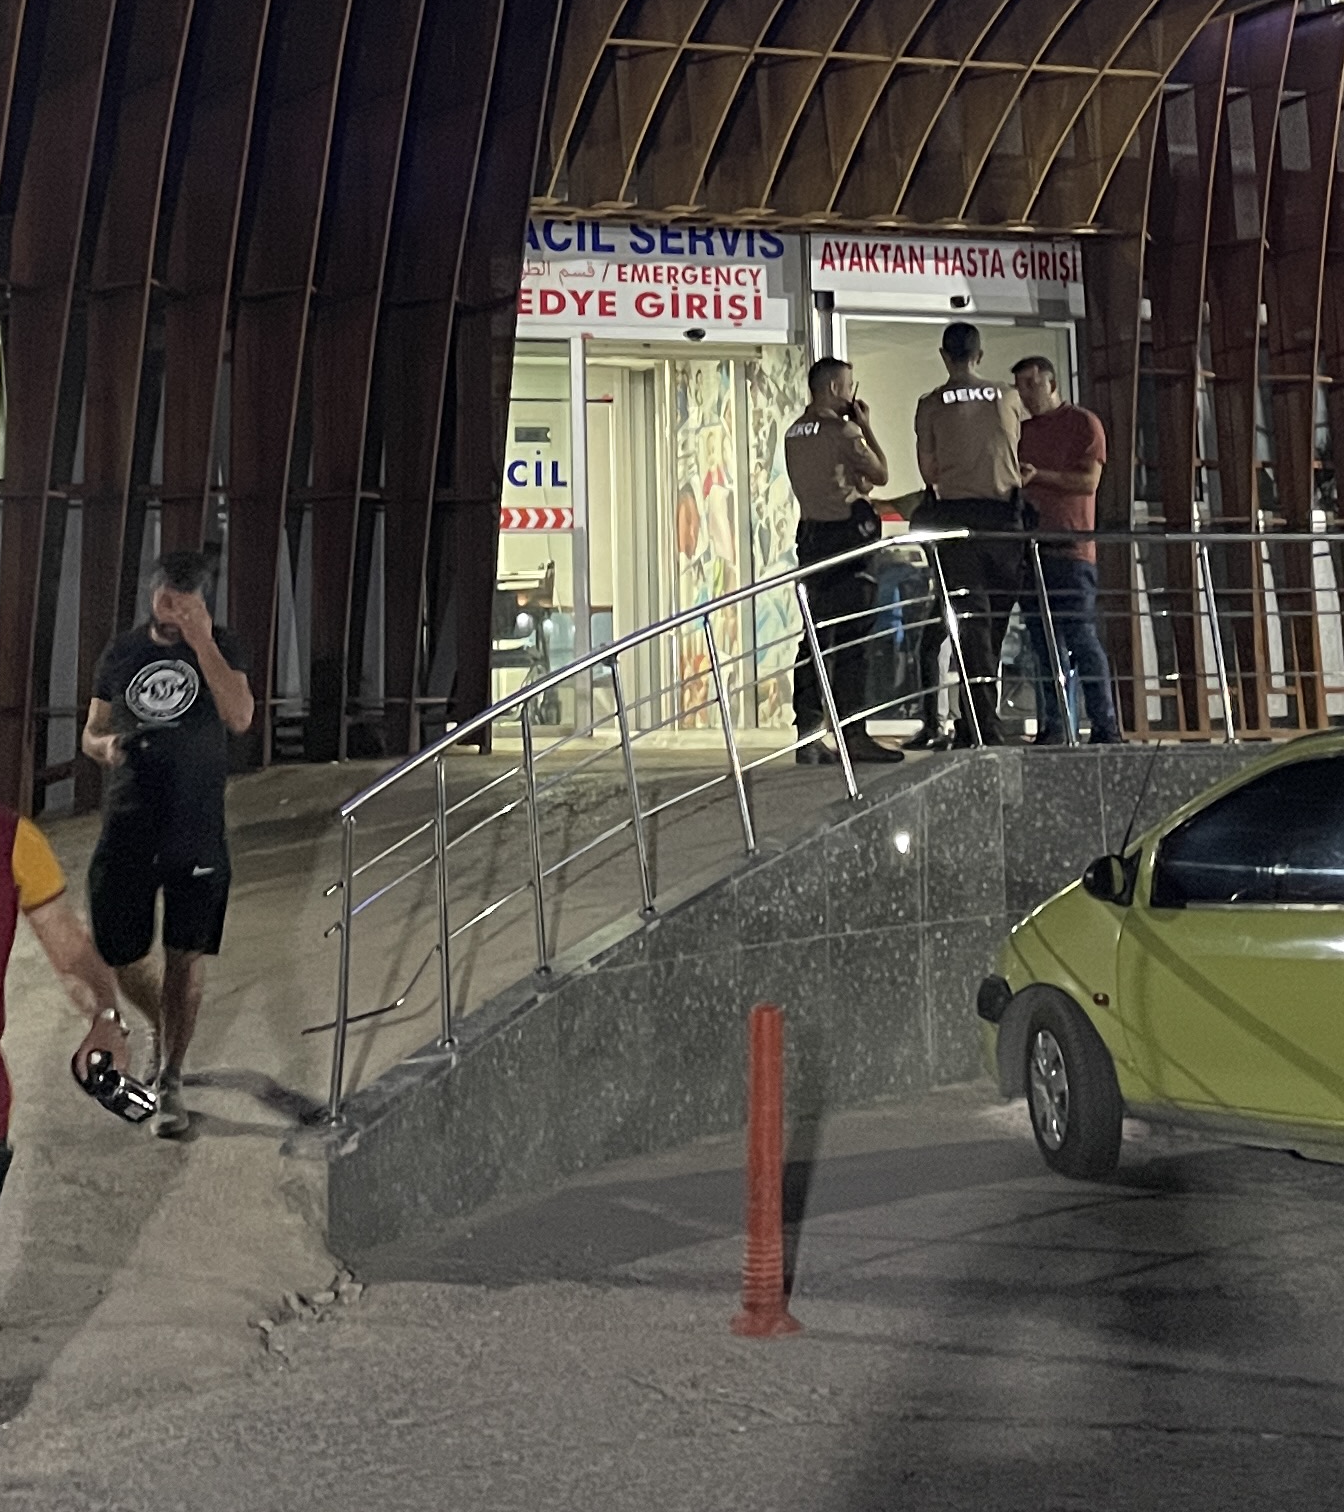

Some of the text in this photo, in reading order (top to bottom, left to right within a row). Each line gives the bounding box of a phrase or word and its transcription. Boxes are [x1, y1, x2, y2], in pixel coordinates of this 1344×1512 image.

[617, 262, 762, 287] EMERGENCY
[820, 241, 1078, 288] AYAKTAN HASTA GİRİŞİ
[634, 285, 763, 327] GİRİŞİ
